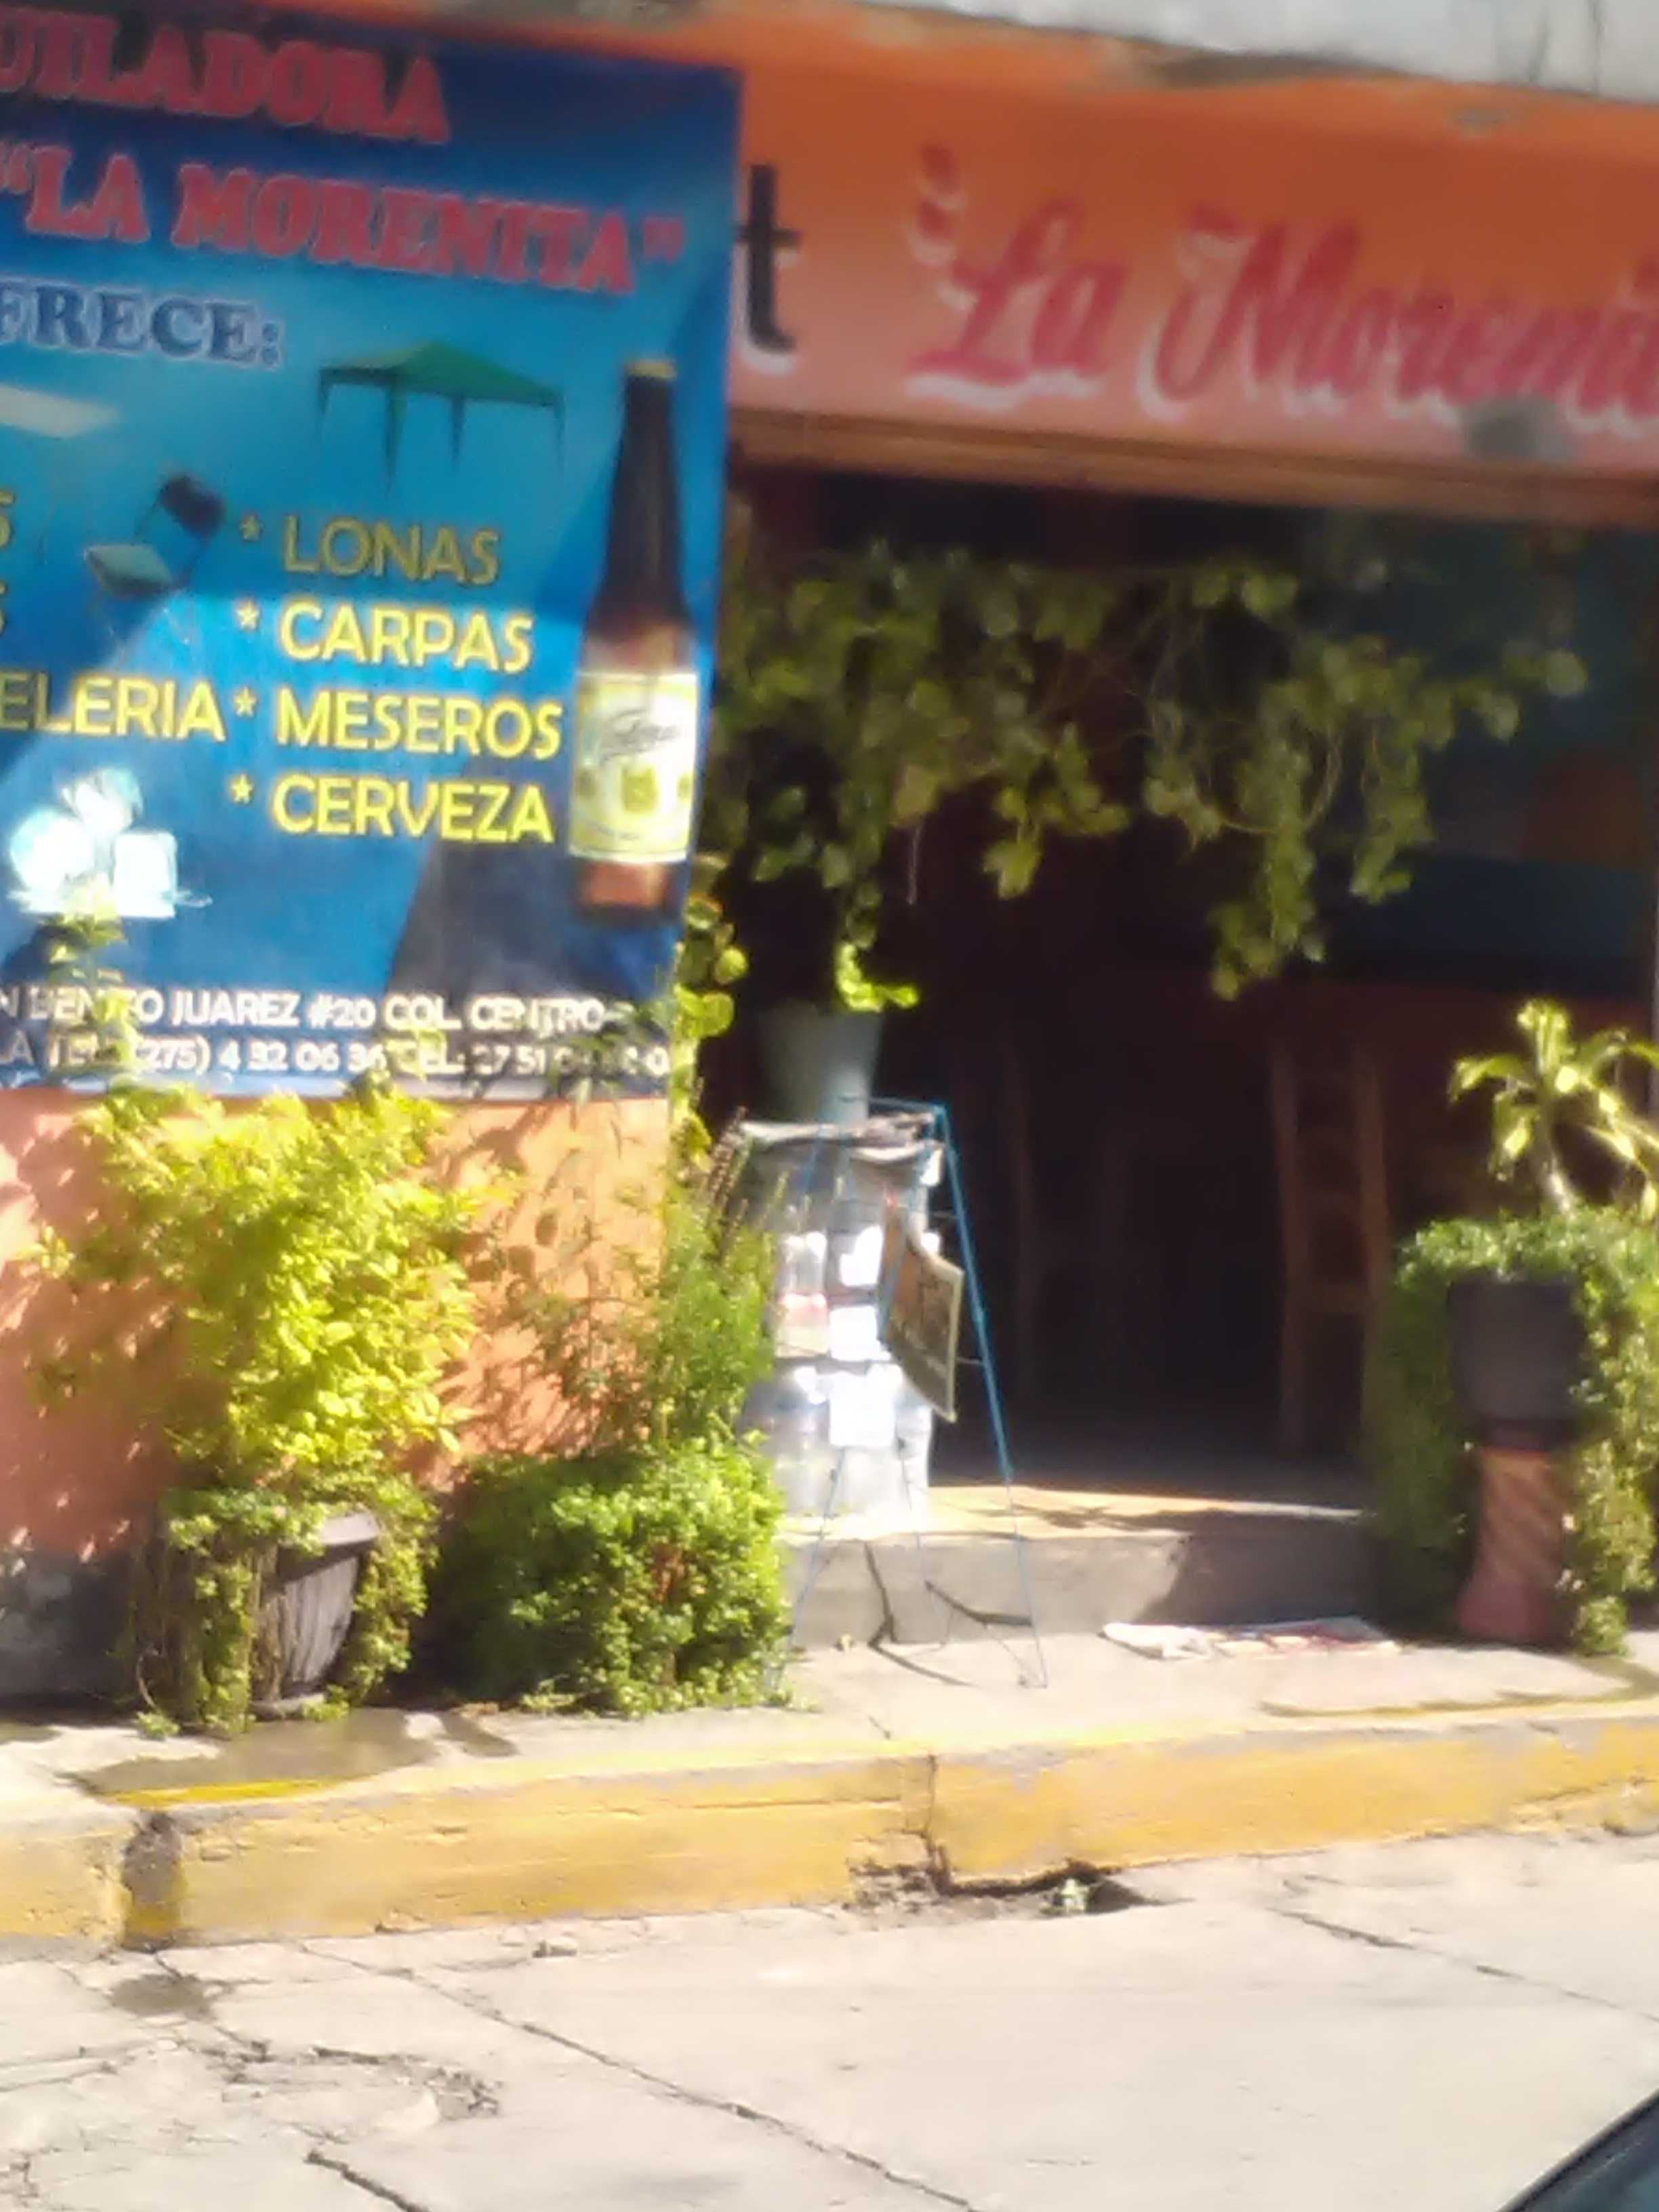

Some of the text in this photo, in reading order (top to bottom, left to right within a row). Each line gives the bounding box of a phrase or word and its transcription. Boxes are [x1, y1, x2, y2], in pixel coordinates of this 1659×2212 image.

[282, 514, 500, 586] LONAS
[279, 600, 533, 673] CARPAS
[275, 687, 564, 760] MESEROS
[272, 771, 554, 843] CERVEZA
[171, 989, 300, 1025] JUAREZ
[307, 994, 377, 1029] #20
